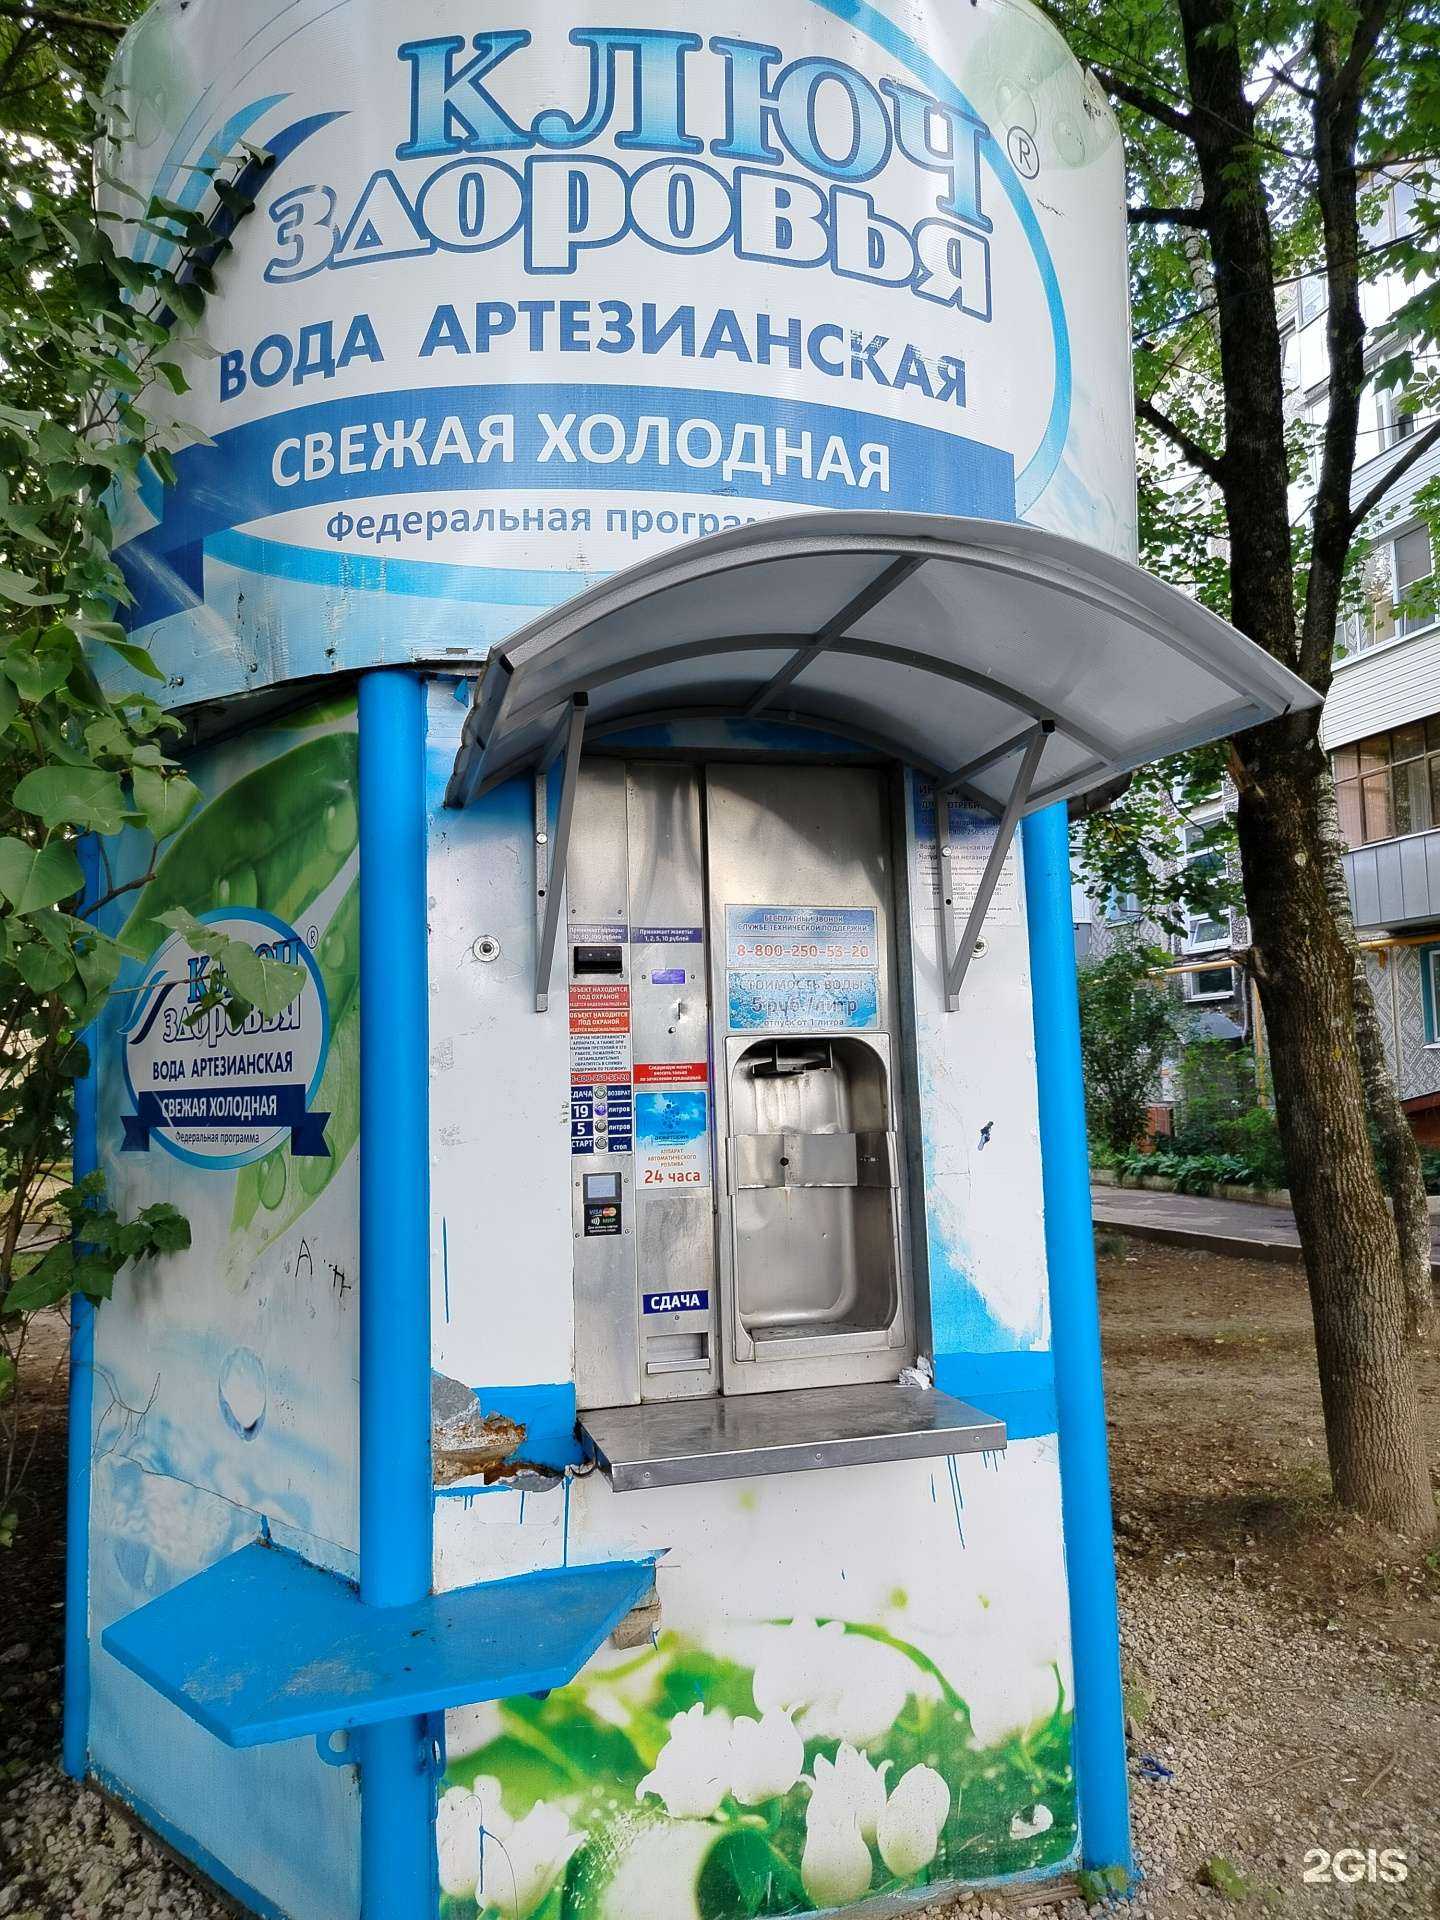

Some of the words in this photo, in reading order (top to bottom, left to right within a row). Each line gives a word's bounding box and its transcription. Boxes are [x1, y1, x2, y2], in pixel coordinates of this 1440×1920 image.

[397, 28, 994, 234] КЛЮЧ
[264, 153, 993, 323] ЗДОРОВЬЯ
[220, 313, 385, 403] ВОДА
[417, 299, 967, 408] АРТЕЗИАНСКАЯ
[271, 413, 514, 488] СВЕЖАЯ
[536, 413, 891, 493] ХОЛОДНАЯ
[326, 507, 591, 542] Федеральная
[606, 508, 756, 540] програ
[770, 923, 821, 931] ТЕХНИЧЕСКОЙ
[737, 944, 869, 957] 8-800-250-53-20
[152, 1060, 186, 1082] ВОДА
[191, 1051, 293, 1078] АРТЕЗИАНСКАЯ
[570, 1090, 593, 1098] СДАЧА
[161, 1097, 207, 1118] СВЕЖАЯ
[209, 1095, 277, 1121] ХОЛОДНАЯ
[574, 1104, 589, 1118] 19
[175, 1130, 219, 1144] Федеральная
[220, 1130, 260, 1144] программа
[577, 1122, 586, 1135] 5
[571, 1139, 593, 1148] СТАРТ
[644, 1169, 664, 1185] 24
[668, 1171, 701, 1183] часа
[650, 1292, 701, 1310] СДАЧА
